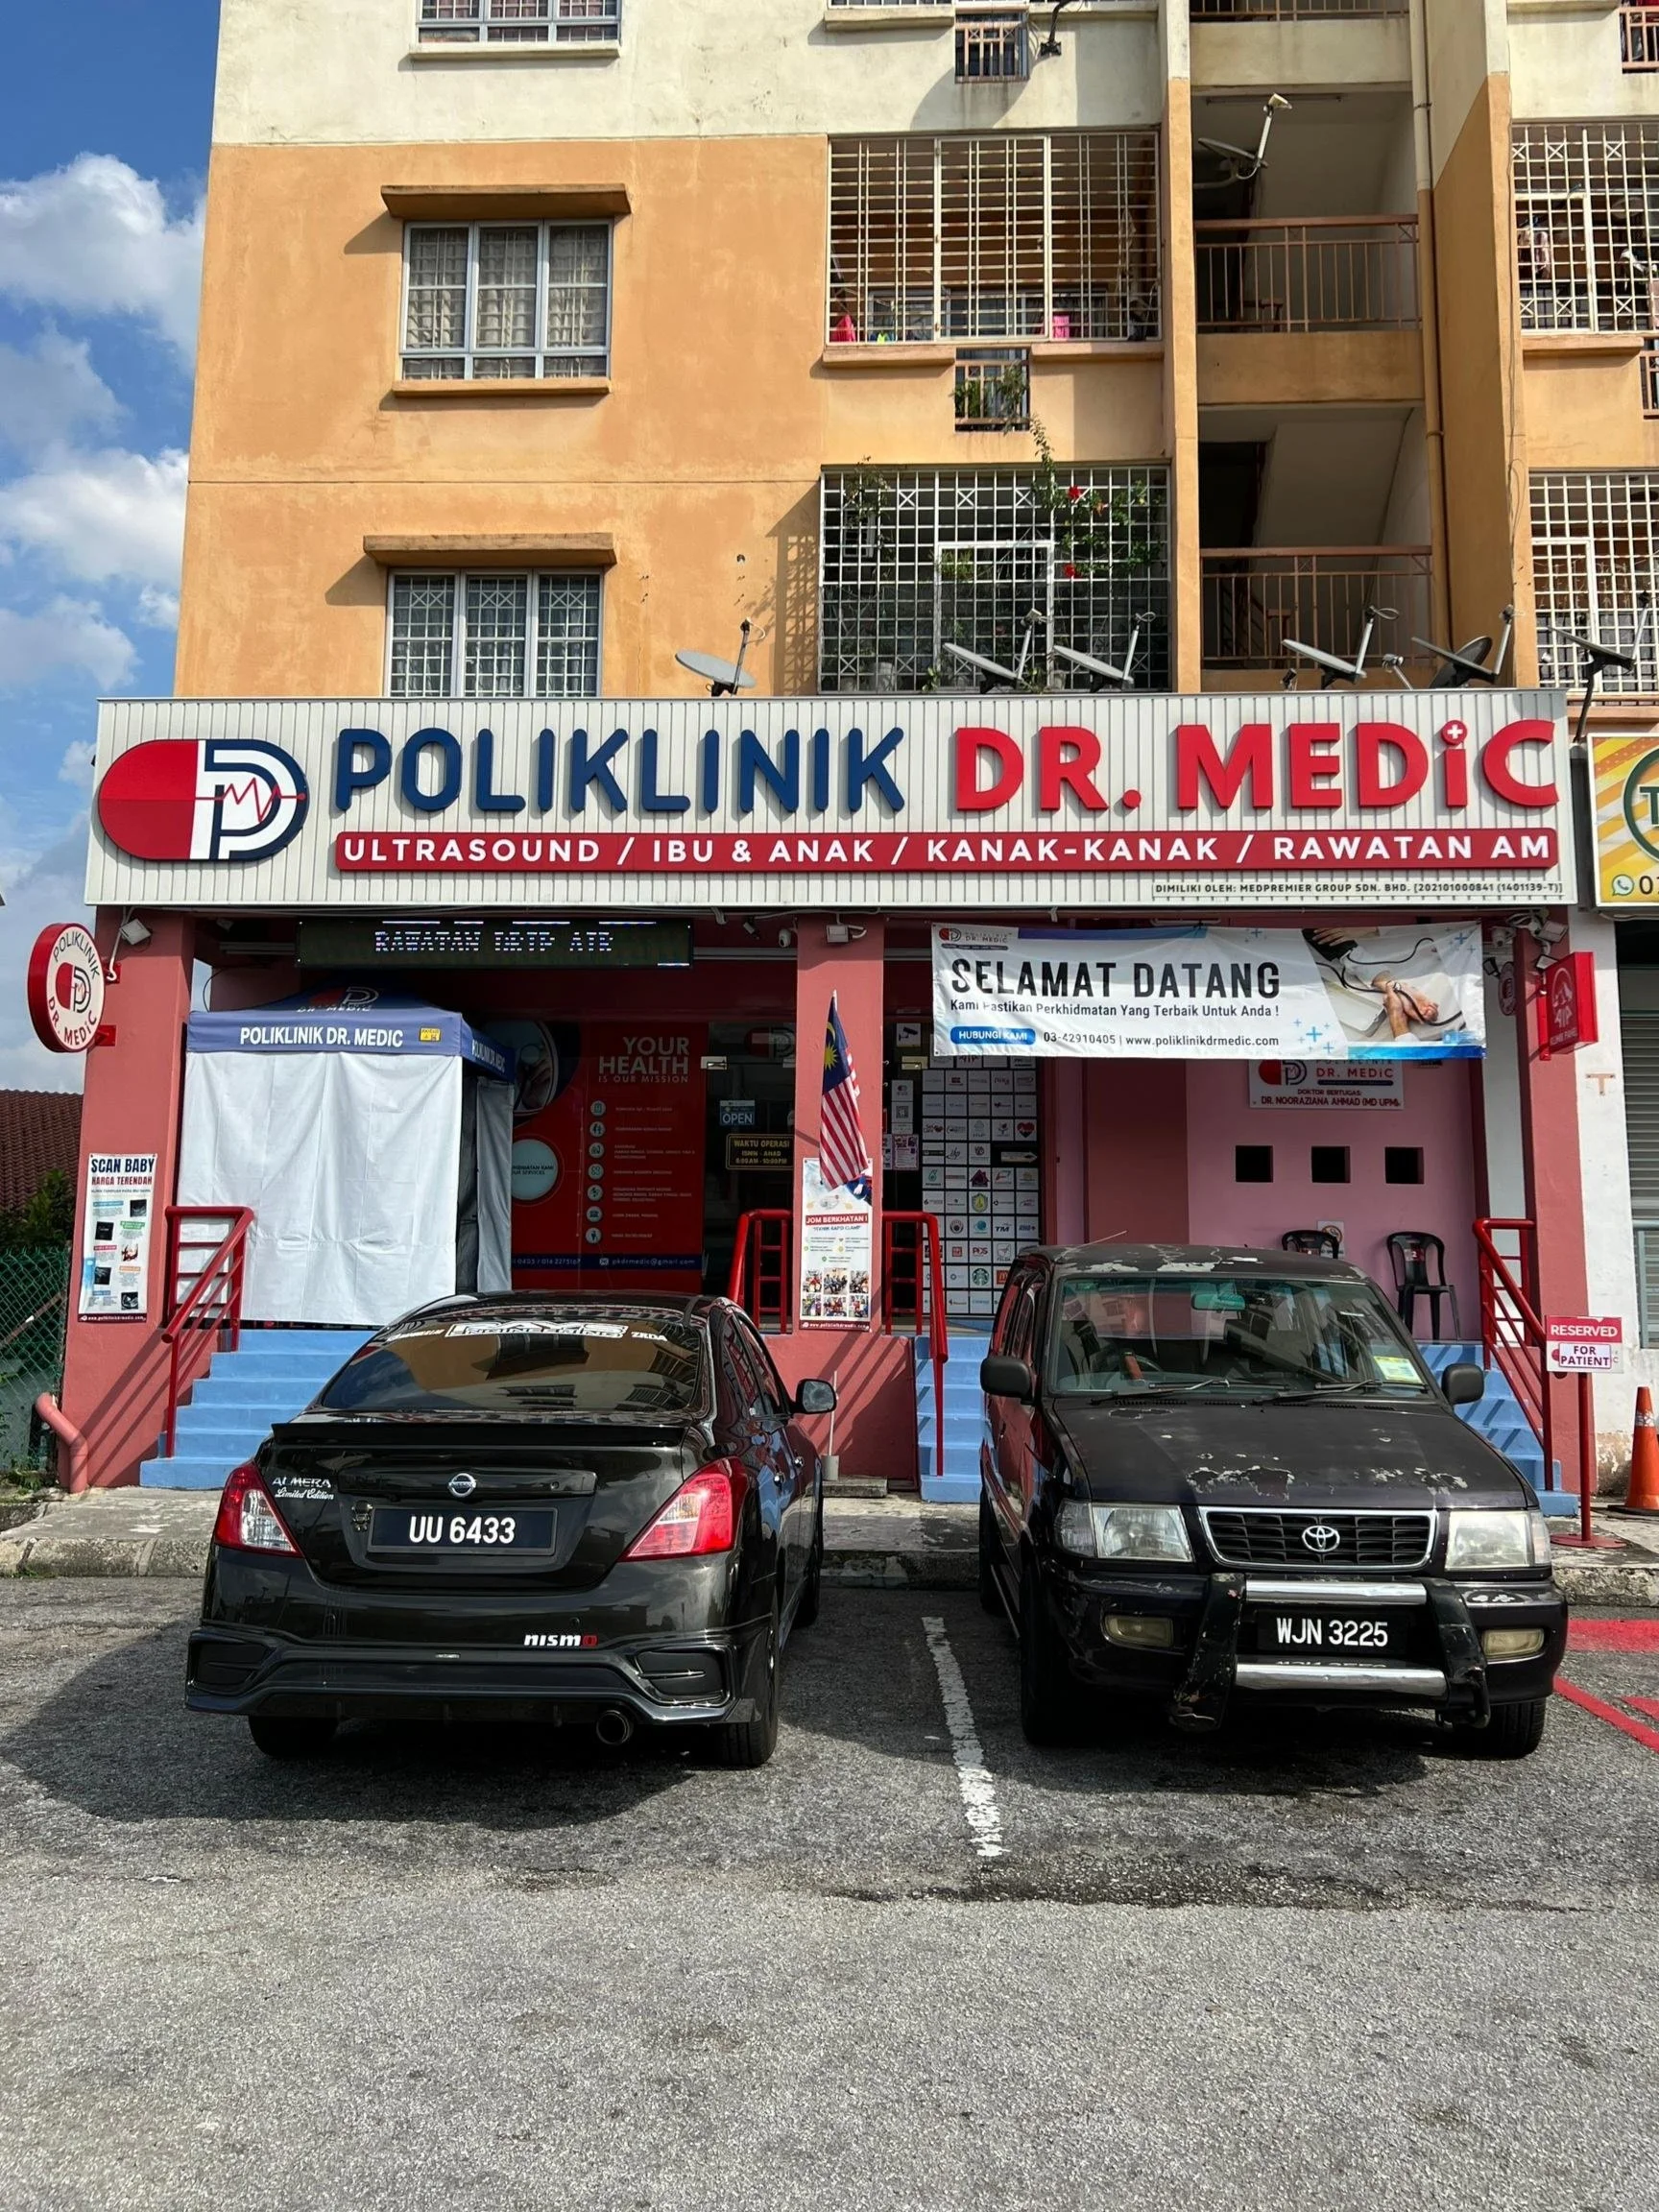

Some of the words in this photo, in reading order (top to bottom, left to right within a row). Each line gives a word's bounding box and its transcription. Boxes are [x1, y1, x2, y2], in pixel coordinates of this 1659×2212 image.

[334, 726, 905, 814] POLIKLINIK
[955, 726, 1142, 811] DR.
[343, 838, 598, 862] ULTRASOUND
[615, 836, 636, 865] /
[653, 839, 713, 862] IBU
[731, 839, 753, 861] &
[769, 838, 874, 862] ANAK
[890, 836, 909, 865] /
[927, 838, 1218, 862] KANAK-KANAK
[1234, 835, 1254, 863] /
[1274, 836, 1472, 860] RAWATAN
[1492, 836, 1551, 858] AM
[1155, 884, 1202, 894] DIMILIKI
[1205, 884, 1237, 894] OLEH:
[1239, 884, 1312, 893] MEDPREMIER
[1315, 883, 1352, 893] GROUP
[1355, 883, 1382, 893] SDN.
[1384, 883, 1411, 893] BHD.
[53, 930, 101, 979] POLIKLINIK
[950, 958, 1117, 998] SELAMAT
[1133, 961, 1280, 999] DATANG
[950, 999, 979, 1011] Kami
[1036, 1003, 1118, 1016] Perkhidmatan
[1121, 1005, 1150, 1019] Yang
[1154, 1005, 1199, 1017] Terbaik
[1202, 1005, 1238, 1017] Untuk
[1240, 1005, 1272, 1017] Anda
[240, 1026, 324, 1046] POLIKLINIK
[325, 1028, 351, 1045] DR.
[354, 1028, 404, 1047] MEDIC
[958, 1030, 1001, 1040] HUBUNGI
[1001, 1032, 1027, 1041] KAMI
[1044, 1032, 1116, 1045] 03-42910405
[1125, 1034, 1280, 1047] www.poliklinikdrmedic.com
[622, 1036, 690, 1056] YOUR
[598, 1056, 689, 1075] HEALTH
[1316, 1068, 1340, 1078] DR.
[1276, 1096, 1330, 1105] NOORAZIANA
[722, 1113, 753, 1124] OPEN
[733, 1140, 758, 1148] WAKTU
[760, 1140, 789, 1148] OPERASI
[91, 1158, 121, 1173] SCAN
[125, 1158, 155, 1173] BABY
[91, 1176, 114, 1186] HARGA
[117, 1176, 152, 1186] TERENDAH
[1551, 1324, 1619, 1337] RESERVED
[1574, 1345, 1597, 1355] FOR
[1561, 1356, 1610, 1366] PATIENT
[275, 1486, 307, 1499] Limited
[306, 1488, 335, 1501] Edition
[408, 1516, 443, 1543] UU
[449, 1516, 517, 1544] 6433
[1276, 1619, 1323, 1645] WJN
[1329, 1621, 1389, 1647] 3225
